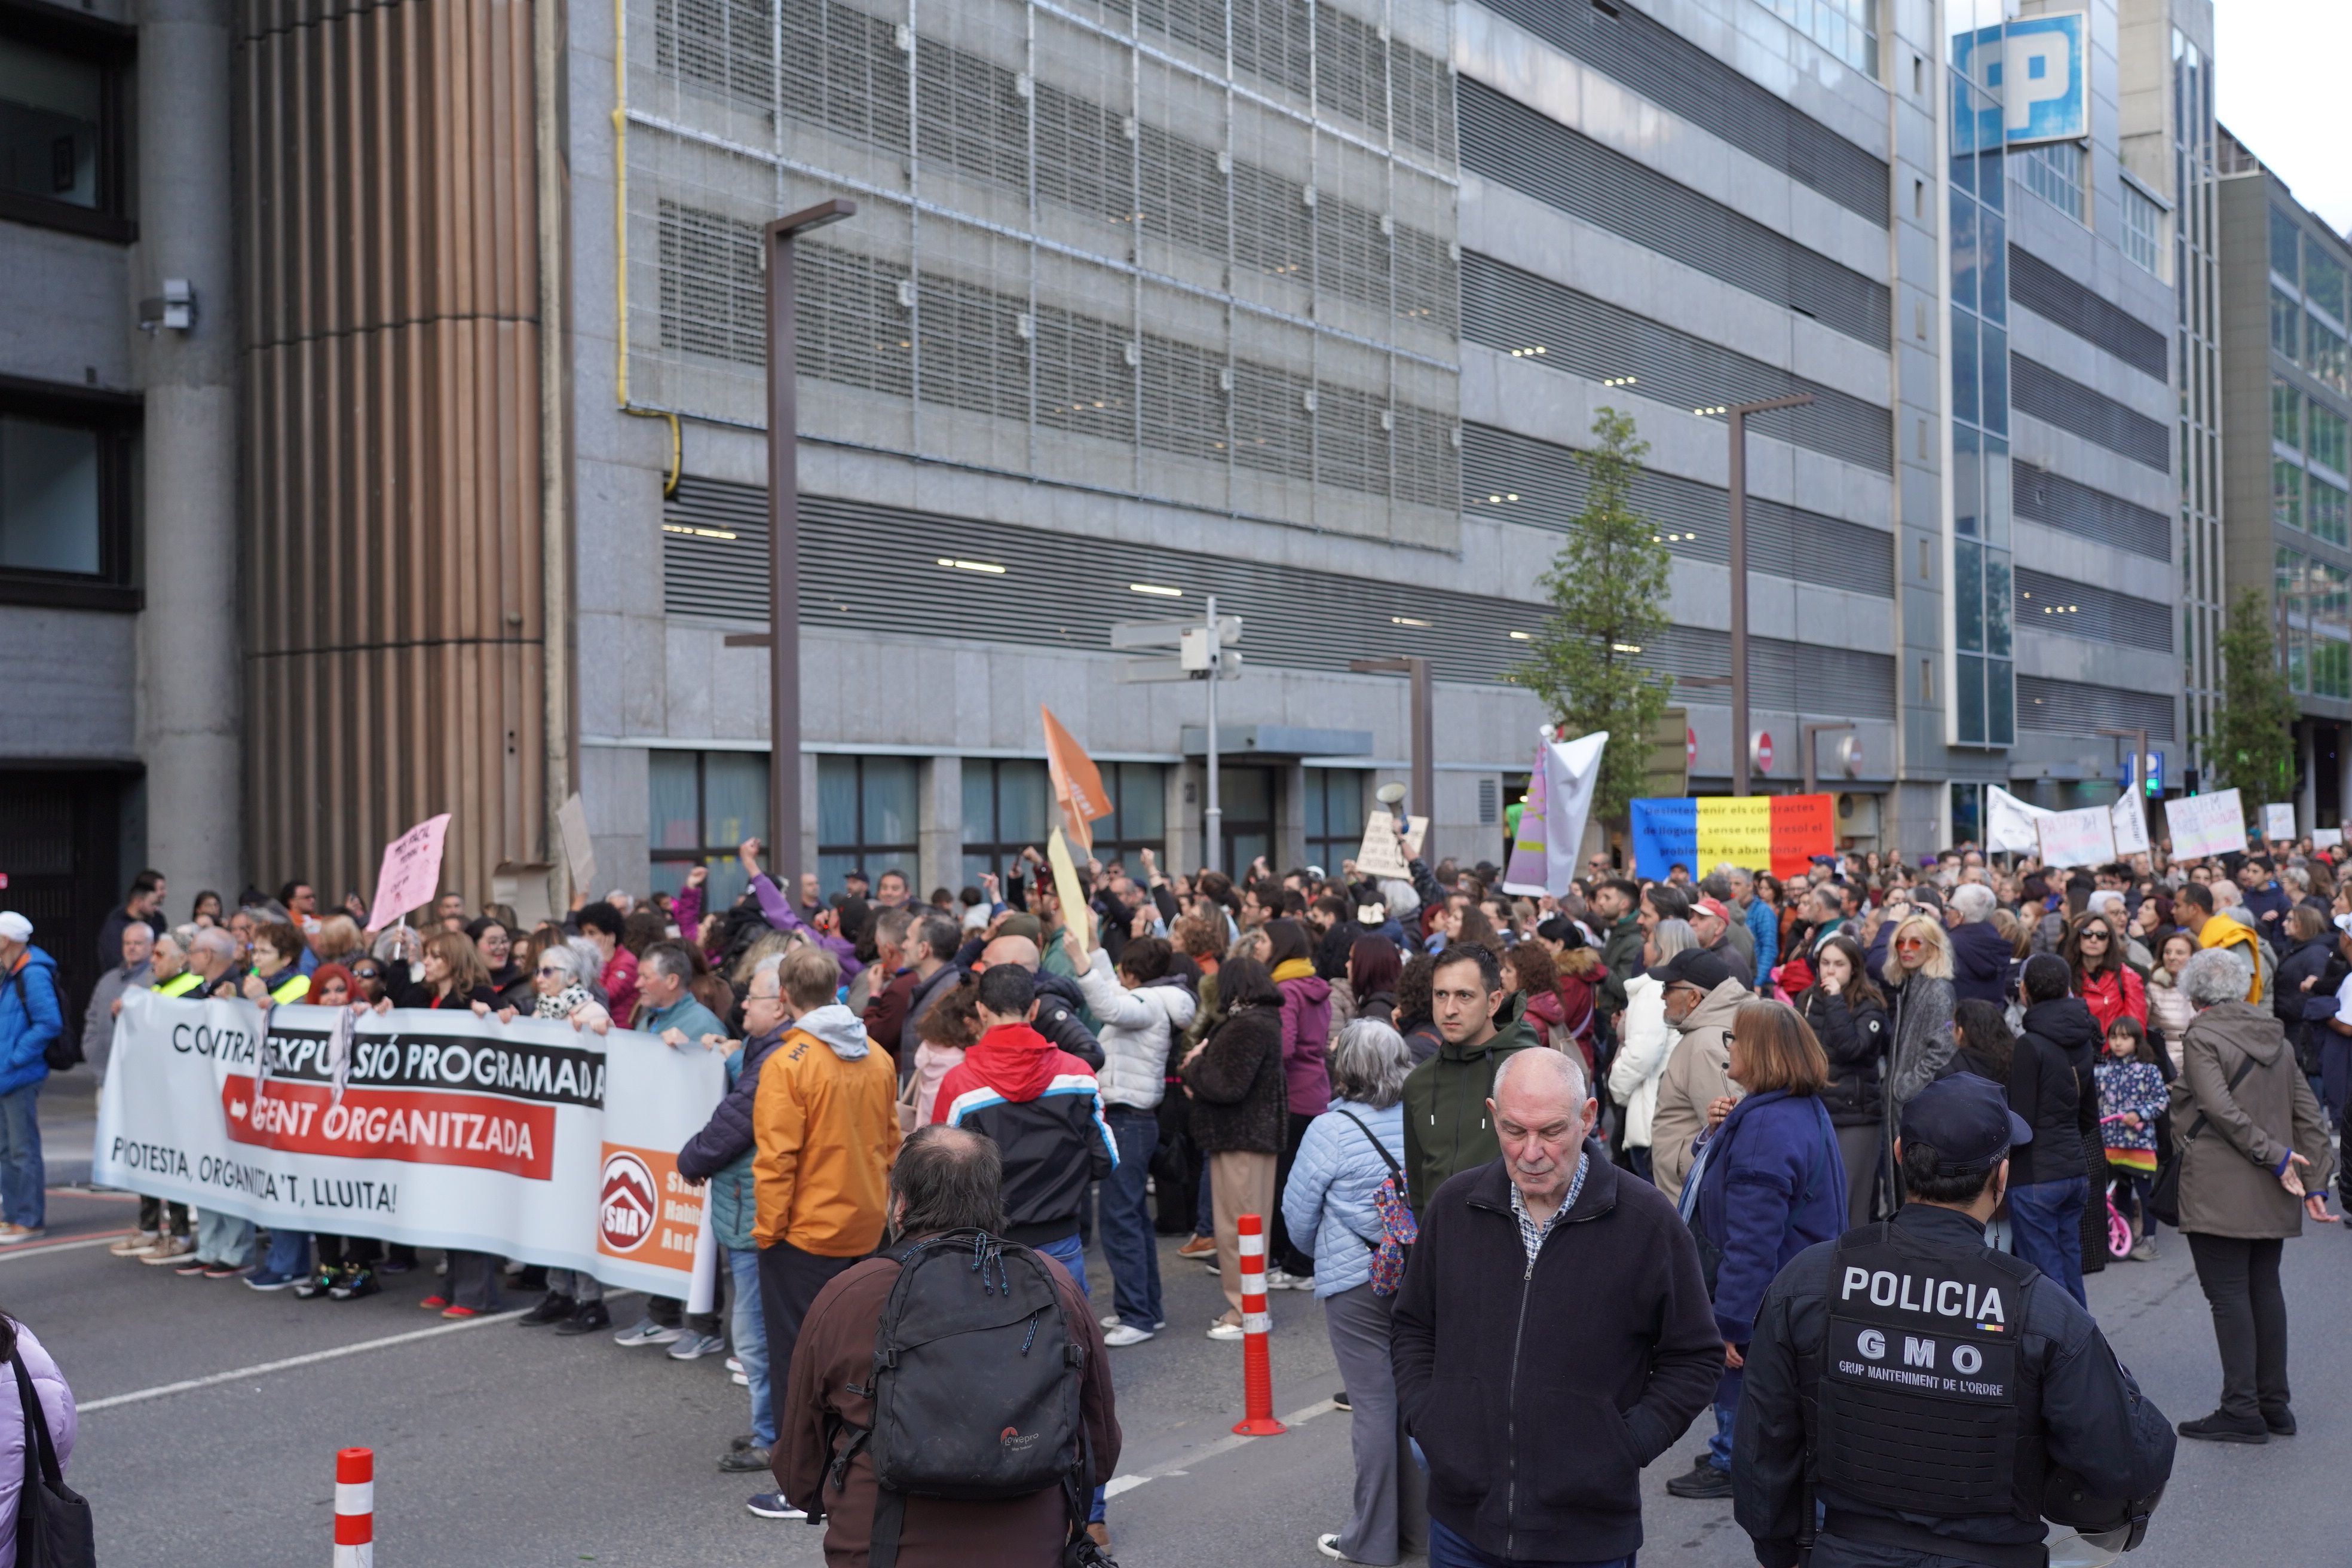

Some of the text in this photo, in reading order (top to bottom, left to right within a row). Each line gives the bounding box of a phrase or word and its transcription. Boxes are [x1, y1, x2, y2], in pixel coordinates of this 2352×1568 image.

[2006, 31, 2069, 130] P
[1731, 806, 1747, 814] els
[1751, 804, 1814, 814] contractes
[1812, 823, 1822, 832] el
[1738, 844, 1802, 855] abandonar
[404, 1043, 605, 1101] PROGRAMADA
[251, 1096, 535, 1161] GENT ORGANITZADA
[112, 1136, 193, 1183] POTESTA,
[312, 1177, 397, 1214] LLUITA!
[605, 1204, 639, 1238] SHA
[1841, 1266, 2005, 1323] POLICIA
[1857, 1329, 1983, 1374] G M O
[1839, 1360, 2004, 1397] GRUP MANTENIMENT DE L'ORDRE
[1004, 1433, 1039, 1446] Lowepro
